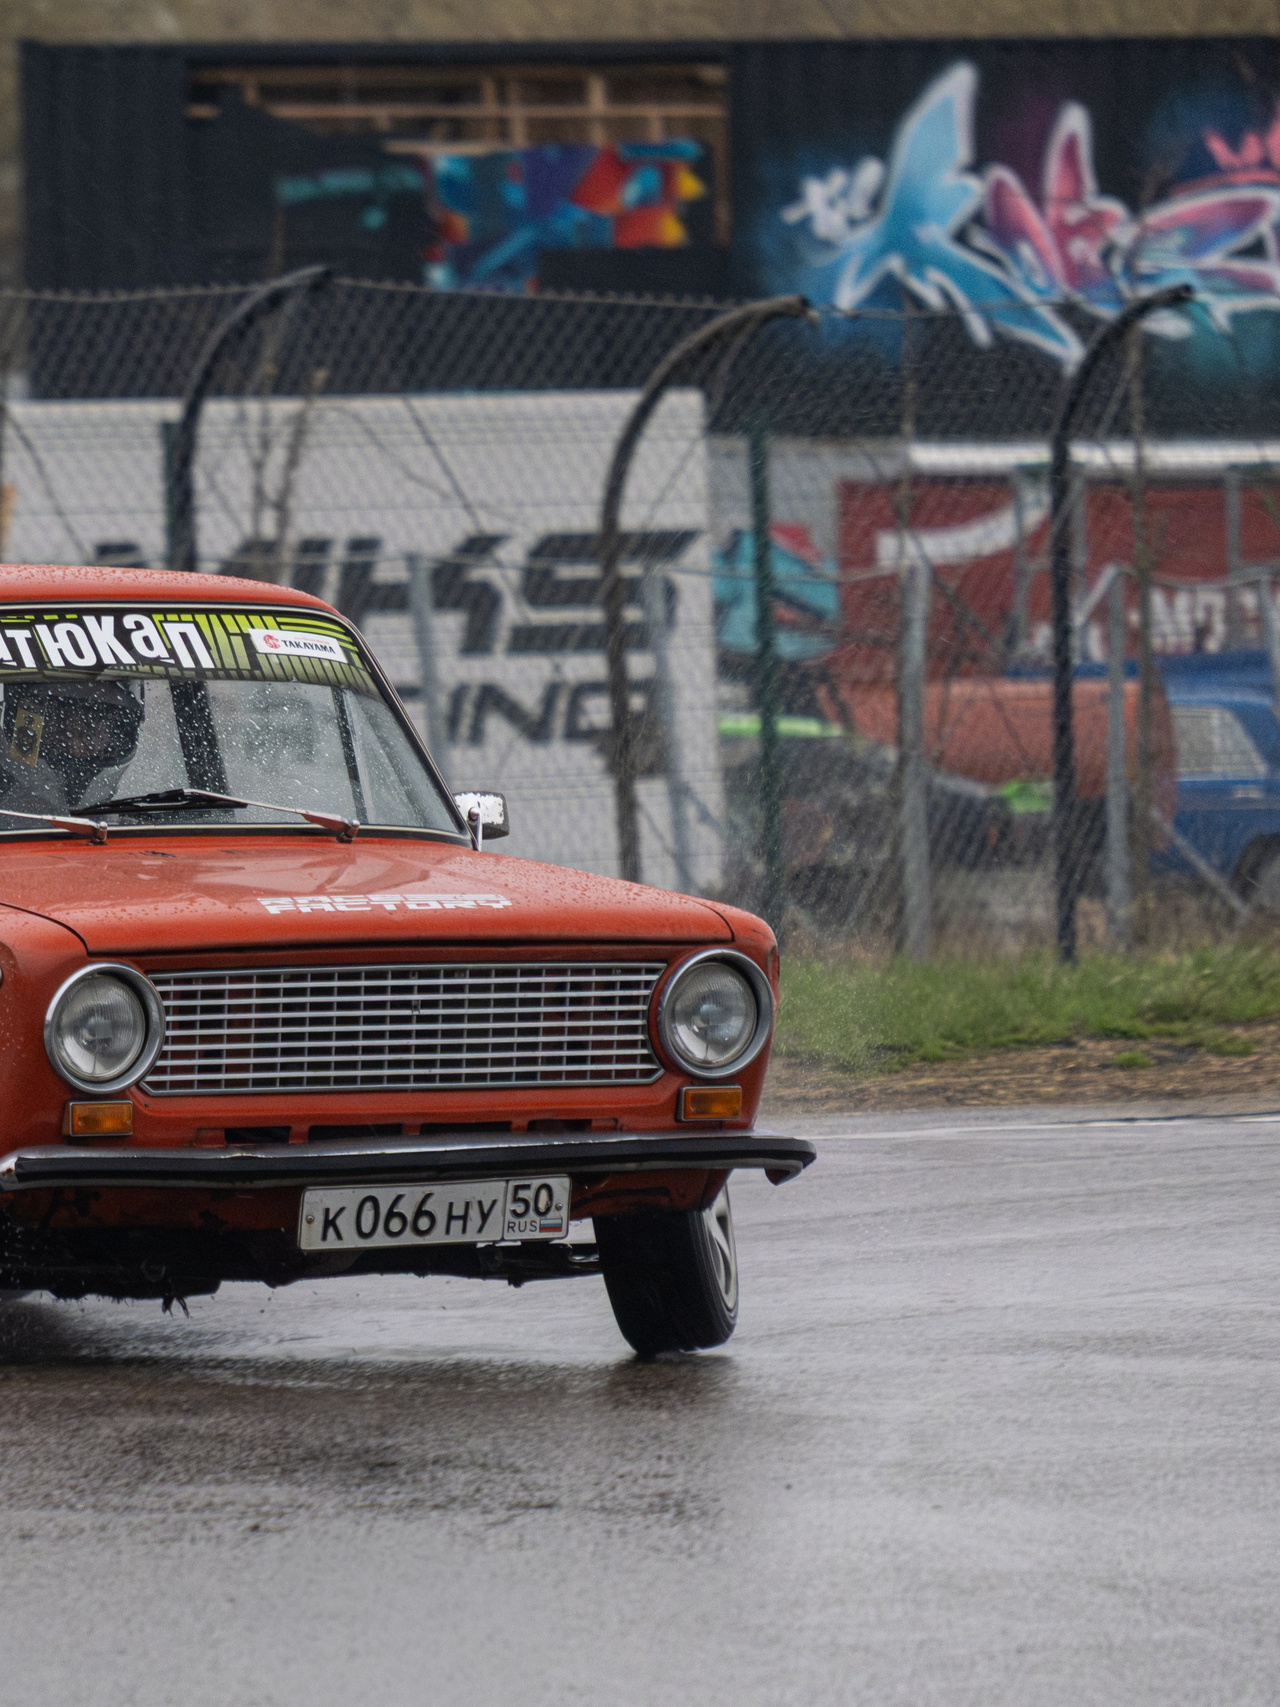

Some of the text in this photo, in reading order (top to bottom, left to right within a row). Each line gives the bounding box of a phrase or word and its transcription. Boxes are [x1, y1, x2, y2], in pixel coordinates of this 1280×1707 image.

[281, 640, 336, 654] TAKAYAMA
[264, 900, 512, 915] FACTORY
[509, 1183, 554, 1219] 50
[506, 1220, 538, 1233] RUS
